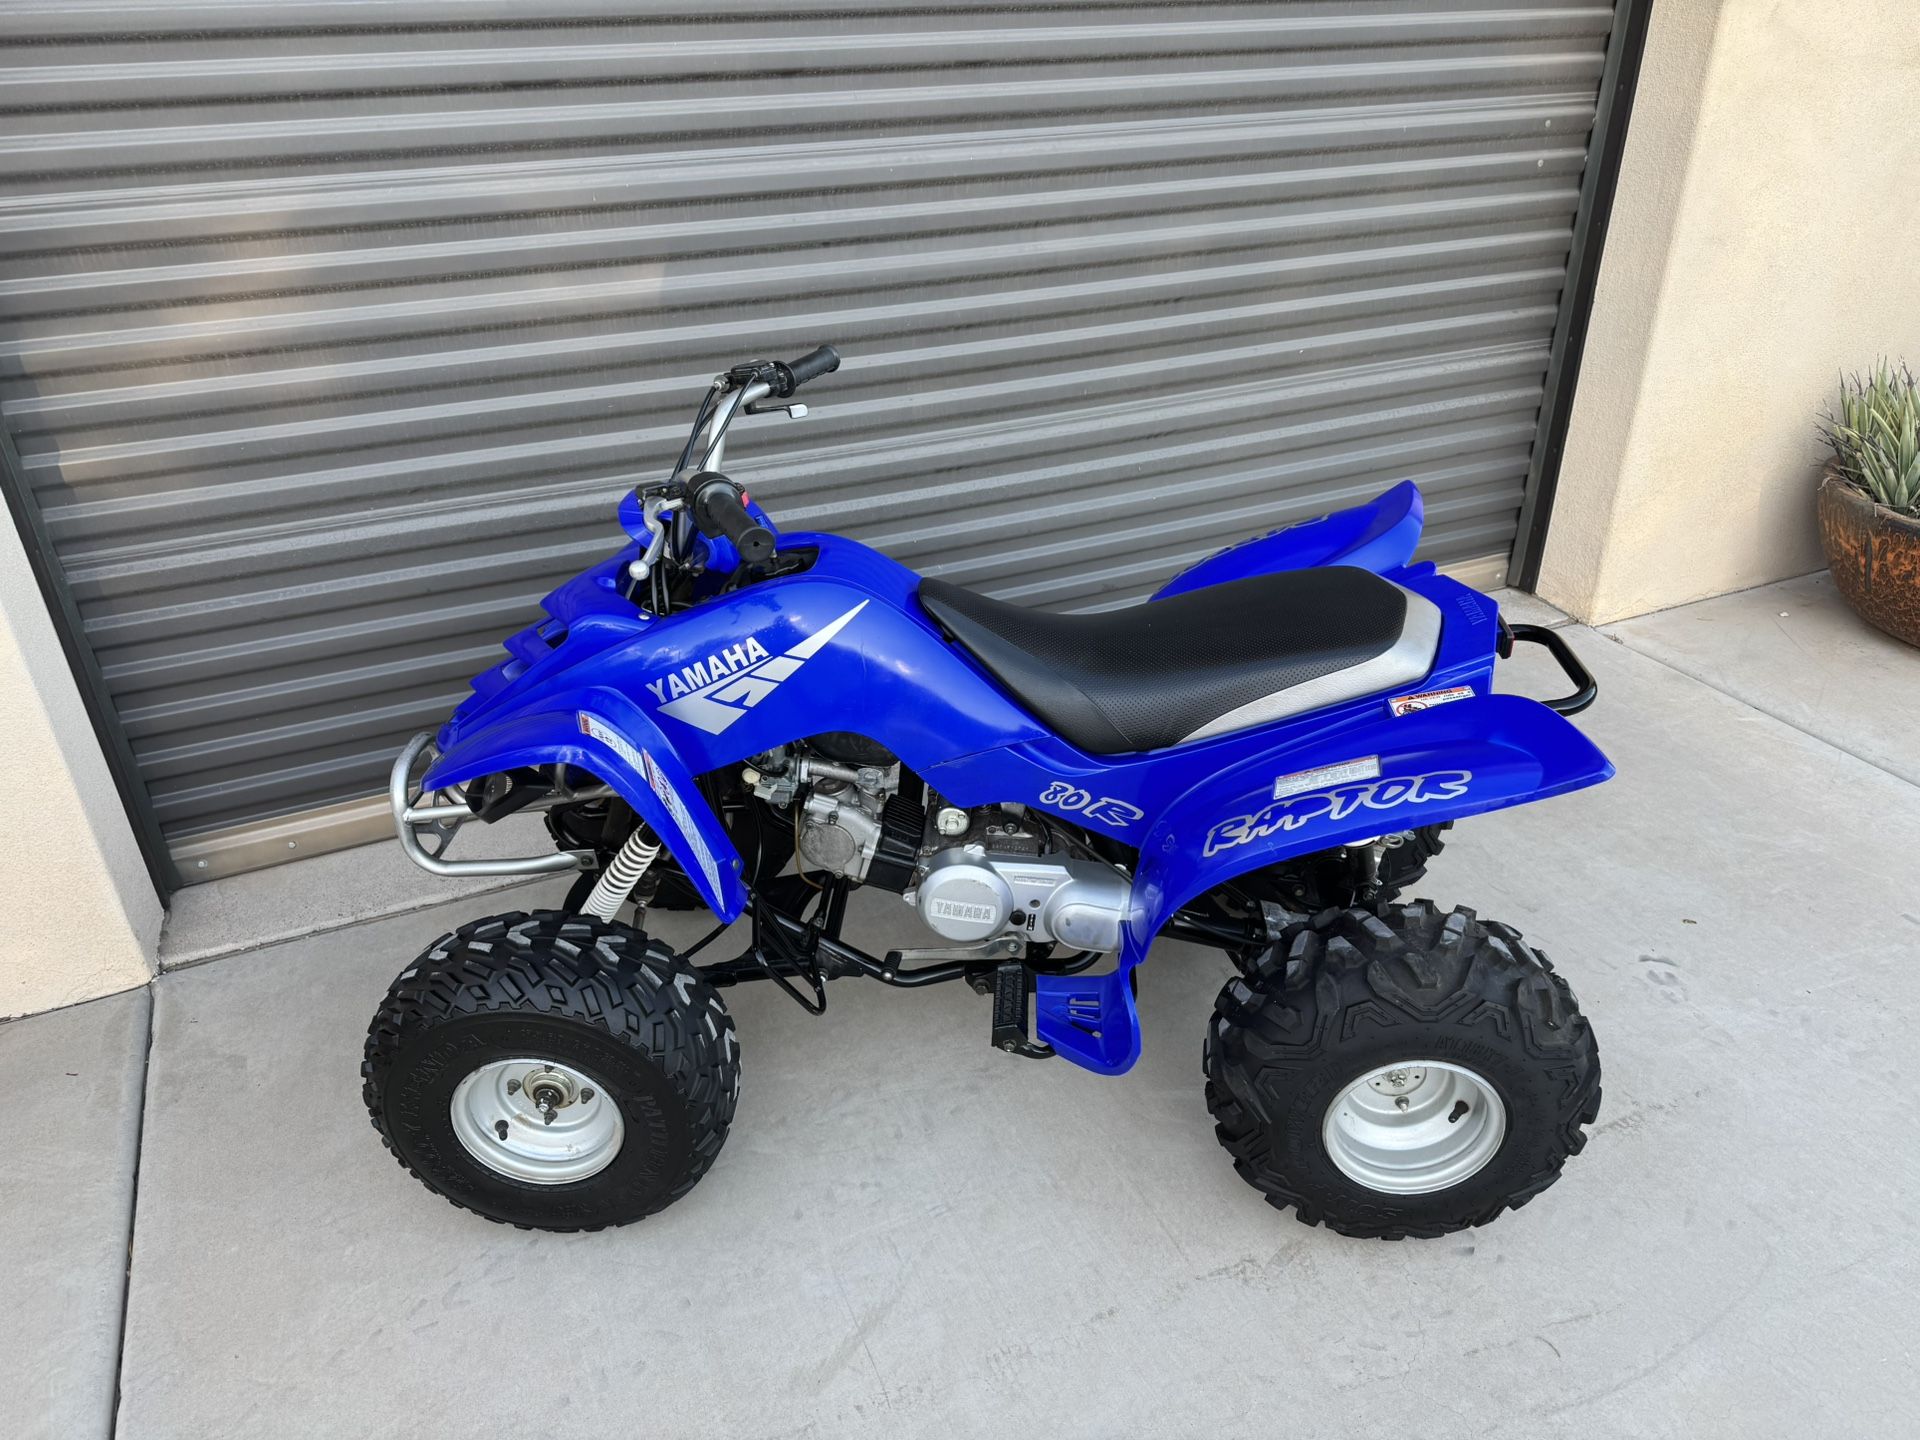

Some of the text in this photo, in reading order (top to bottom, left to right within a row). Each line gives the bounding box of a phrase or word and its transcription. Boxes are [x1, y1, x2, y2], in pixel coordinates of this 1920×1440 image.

[646, 637, 770, 703] YAMAHA
[1416, 690, 1453, 698] WARNING
[1203, 770, 1472, 856] RAPTOR
[936, 901, 991, 920] YAMAHA
